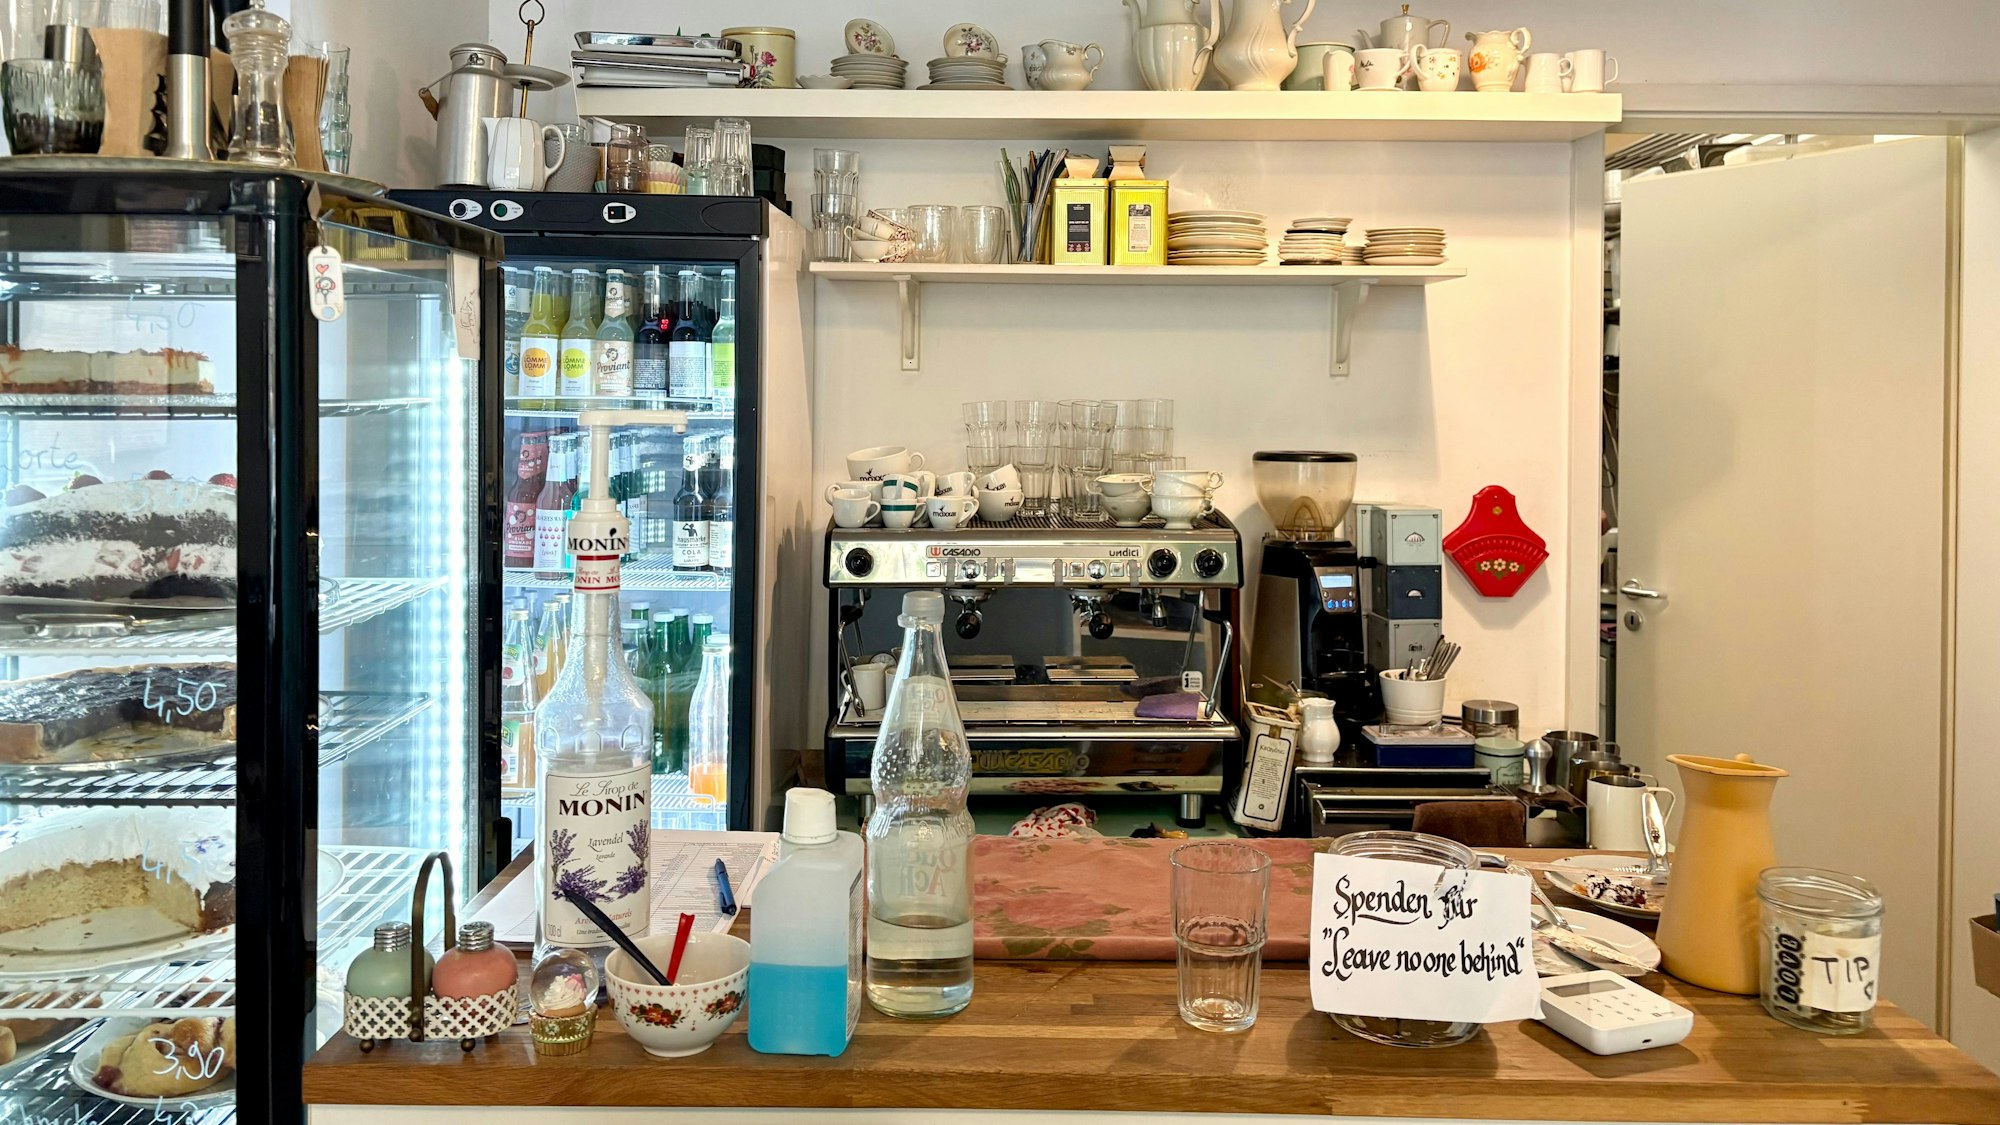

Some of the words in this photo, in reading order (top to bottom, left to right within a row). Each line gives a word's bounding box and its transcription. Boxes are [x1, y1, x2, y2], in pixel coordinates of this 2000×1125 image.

[567, 536, 627, 551] MONIN
[942, 548, 981, 557] CASADIO
[1108, 547, 1139, 557] undici
[143, 678, 226, 724] 4,50
[569, 781, 590, 797] Le
[593, 780, 626, 797] Sirop
[627, 780, 639, 790] de
[559, 793, 646, 816] MONIN
[587, 832, 624, 852] Lavendel
[1333, 874, 1432, 926] Spenden
[1437, 885, 1478, 929] für
[1776, 933, 1802, 1004] LOVE
[1811, 956, 1870, 984] TIP
[148, 1037, 225, 1081] 3,90
